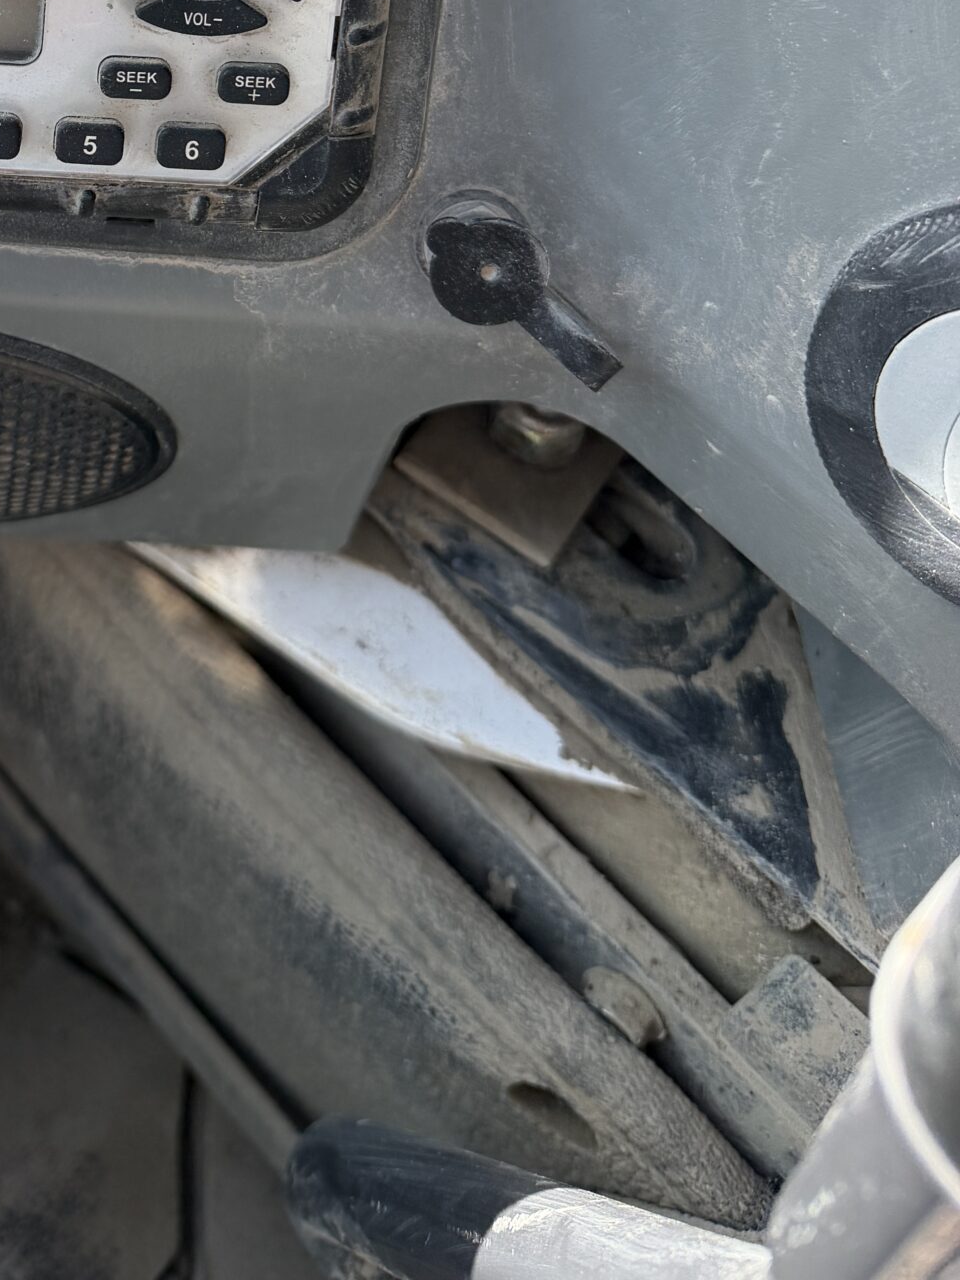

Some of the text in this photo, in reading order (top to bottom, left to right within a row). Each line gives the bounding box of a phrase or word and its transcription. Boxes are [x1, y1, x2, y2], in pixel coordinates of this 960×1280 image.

[116, 70, 157, 84] SEEK
[234, 74, 276, 90] SEEK
[82, 135, 97, 155] 5
[185, 140, 199, 161] 6
